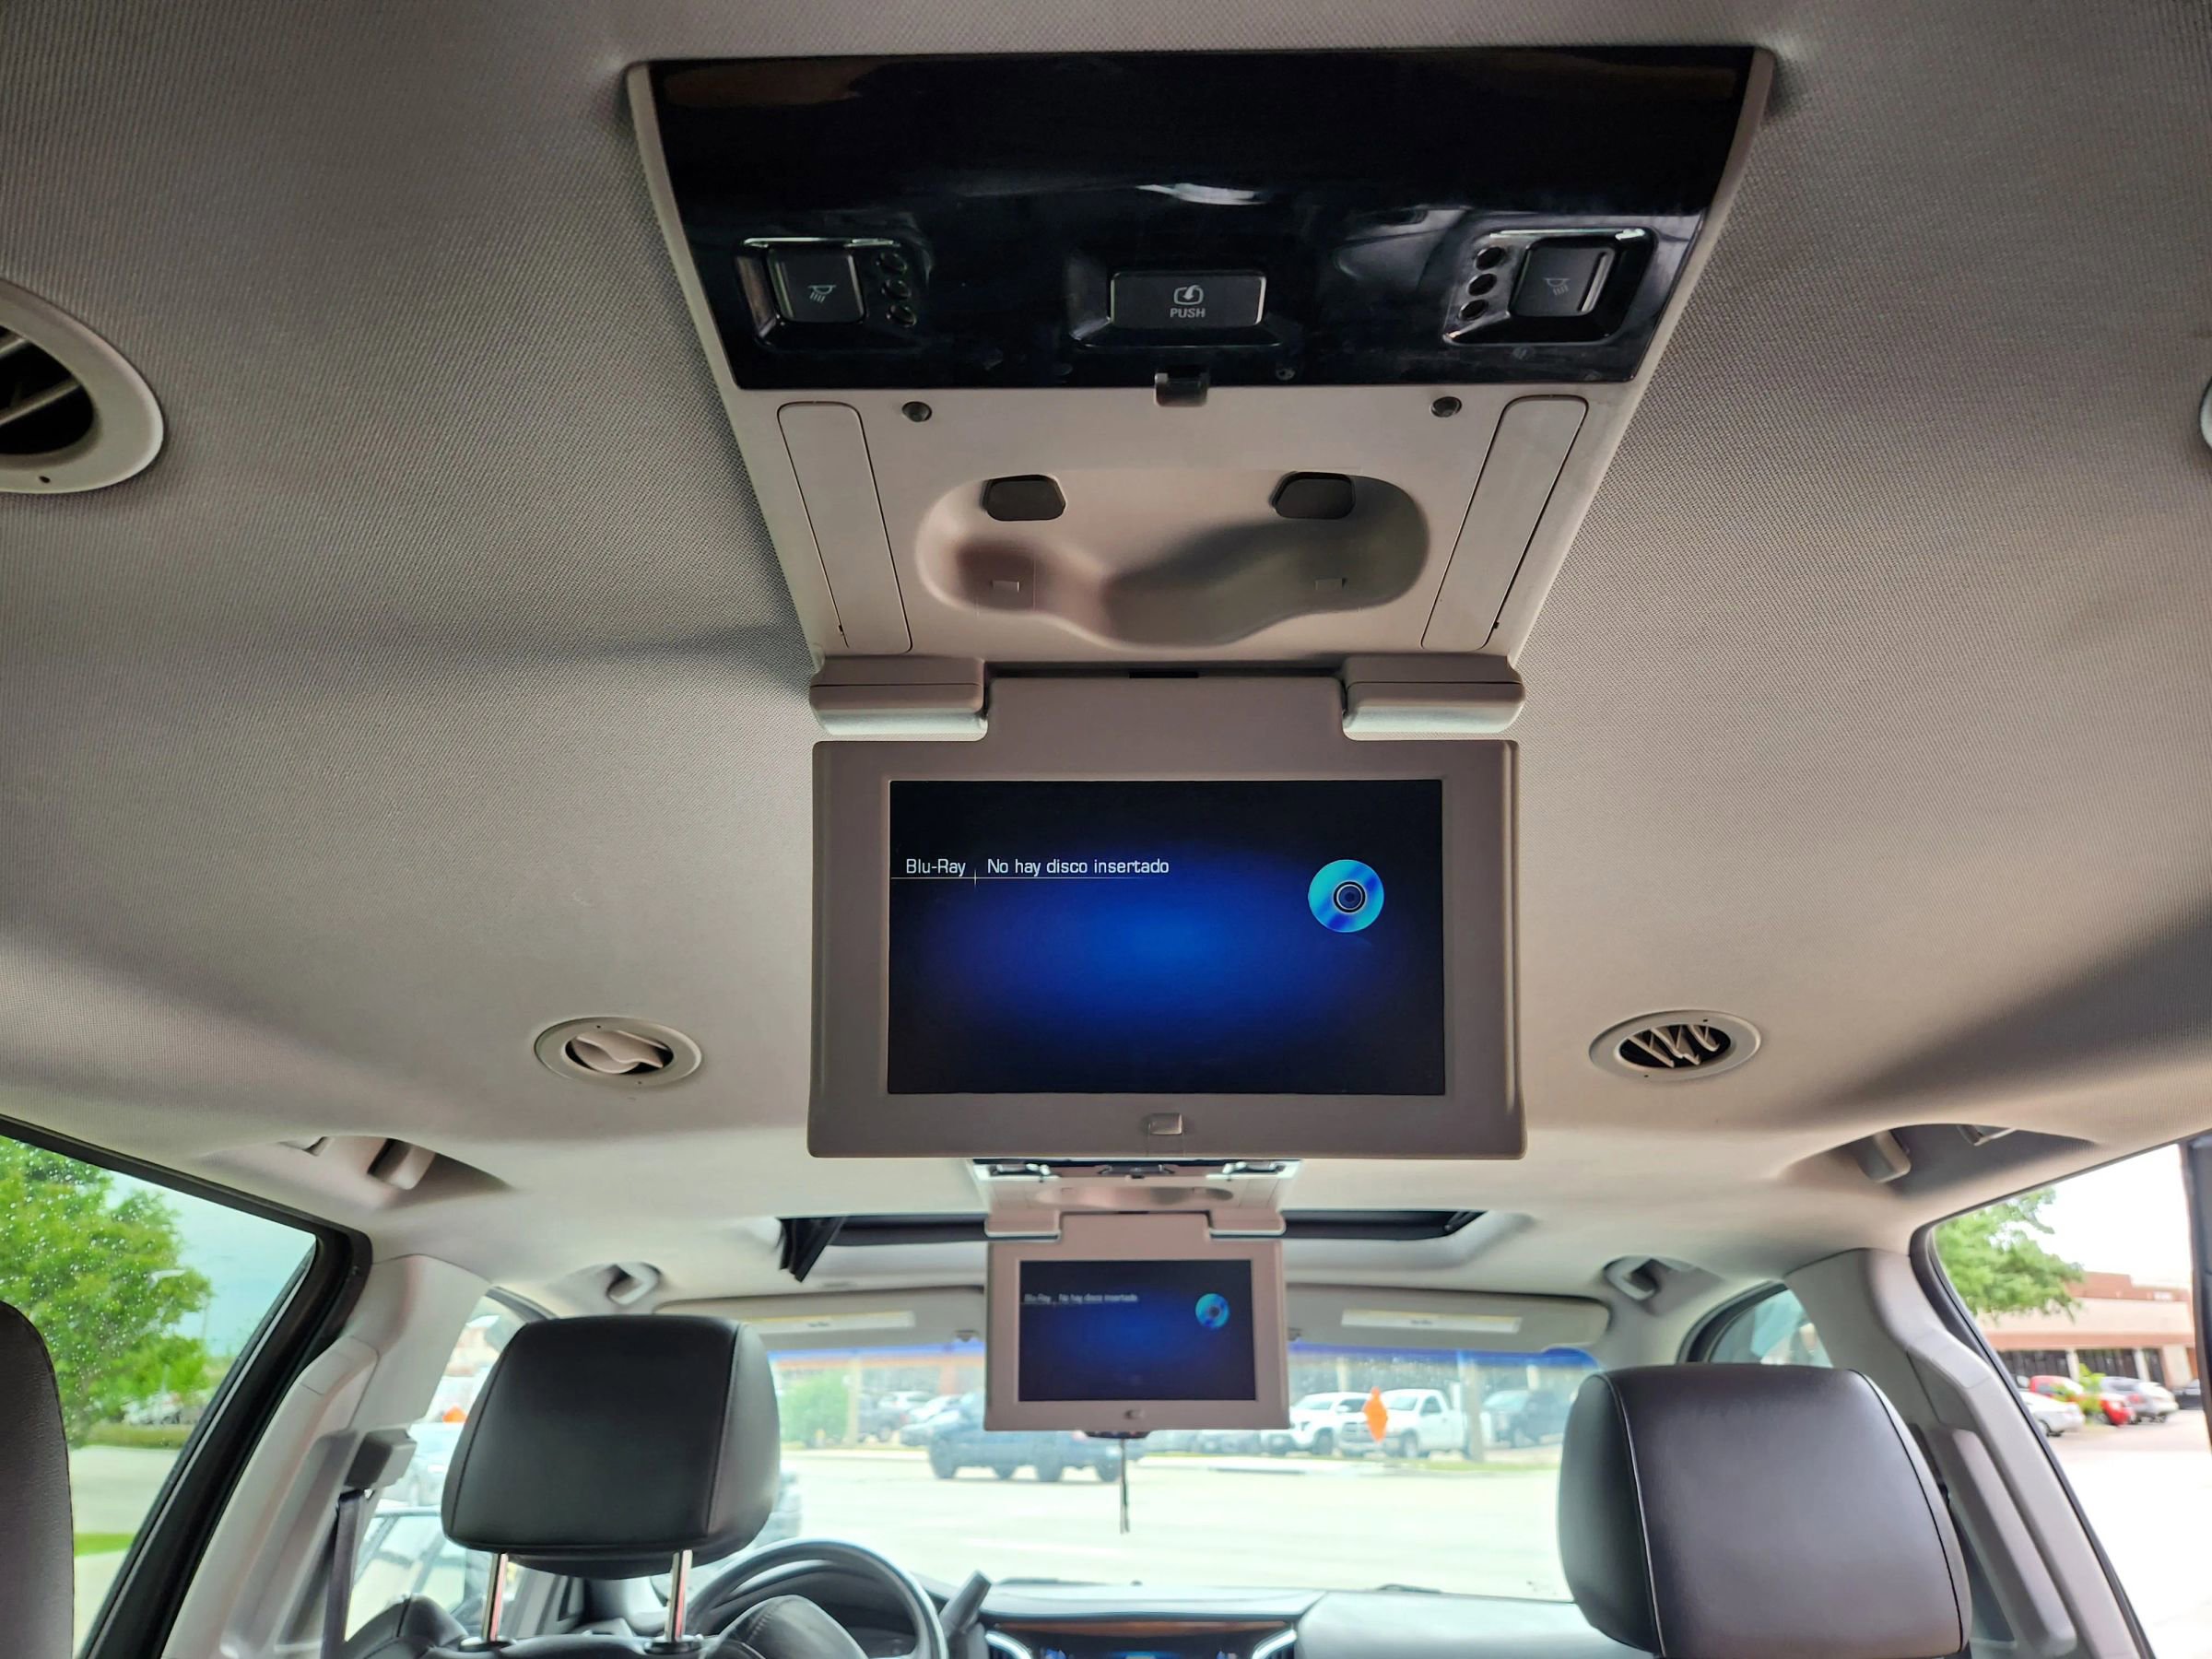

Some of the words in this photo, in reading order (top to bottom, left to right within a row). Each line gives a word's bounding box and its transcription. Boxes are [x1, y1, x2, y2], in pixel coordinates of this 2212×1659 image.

[1170, 308, 1206, 319] PUSH
[906, 858, 966, 877] Blu-Ray
[987, 858, 1008, 875] No
[1015, 858, 1041, 877] hay
[1046, 858, 1088, 875] disco
[1094, 858, 1170, 875] insertado
